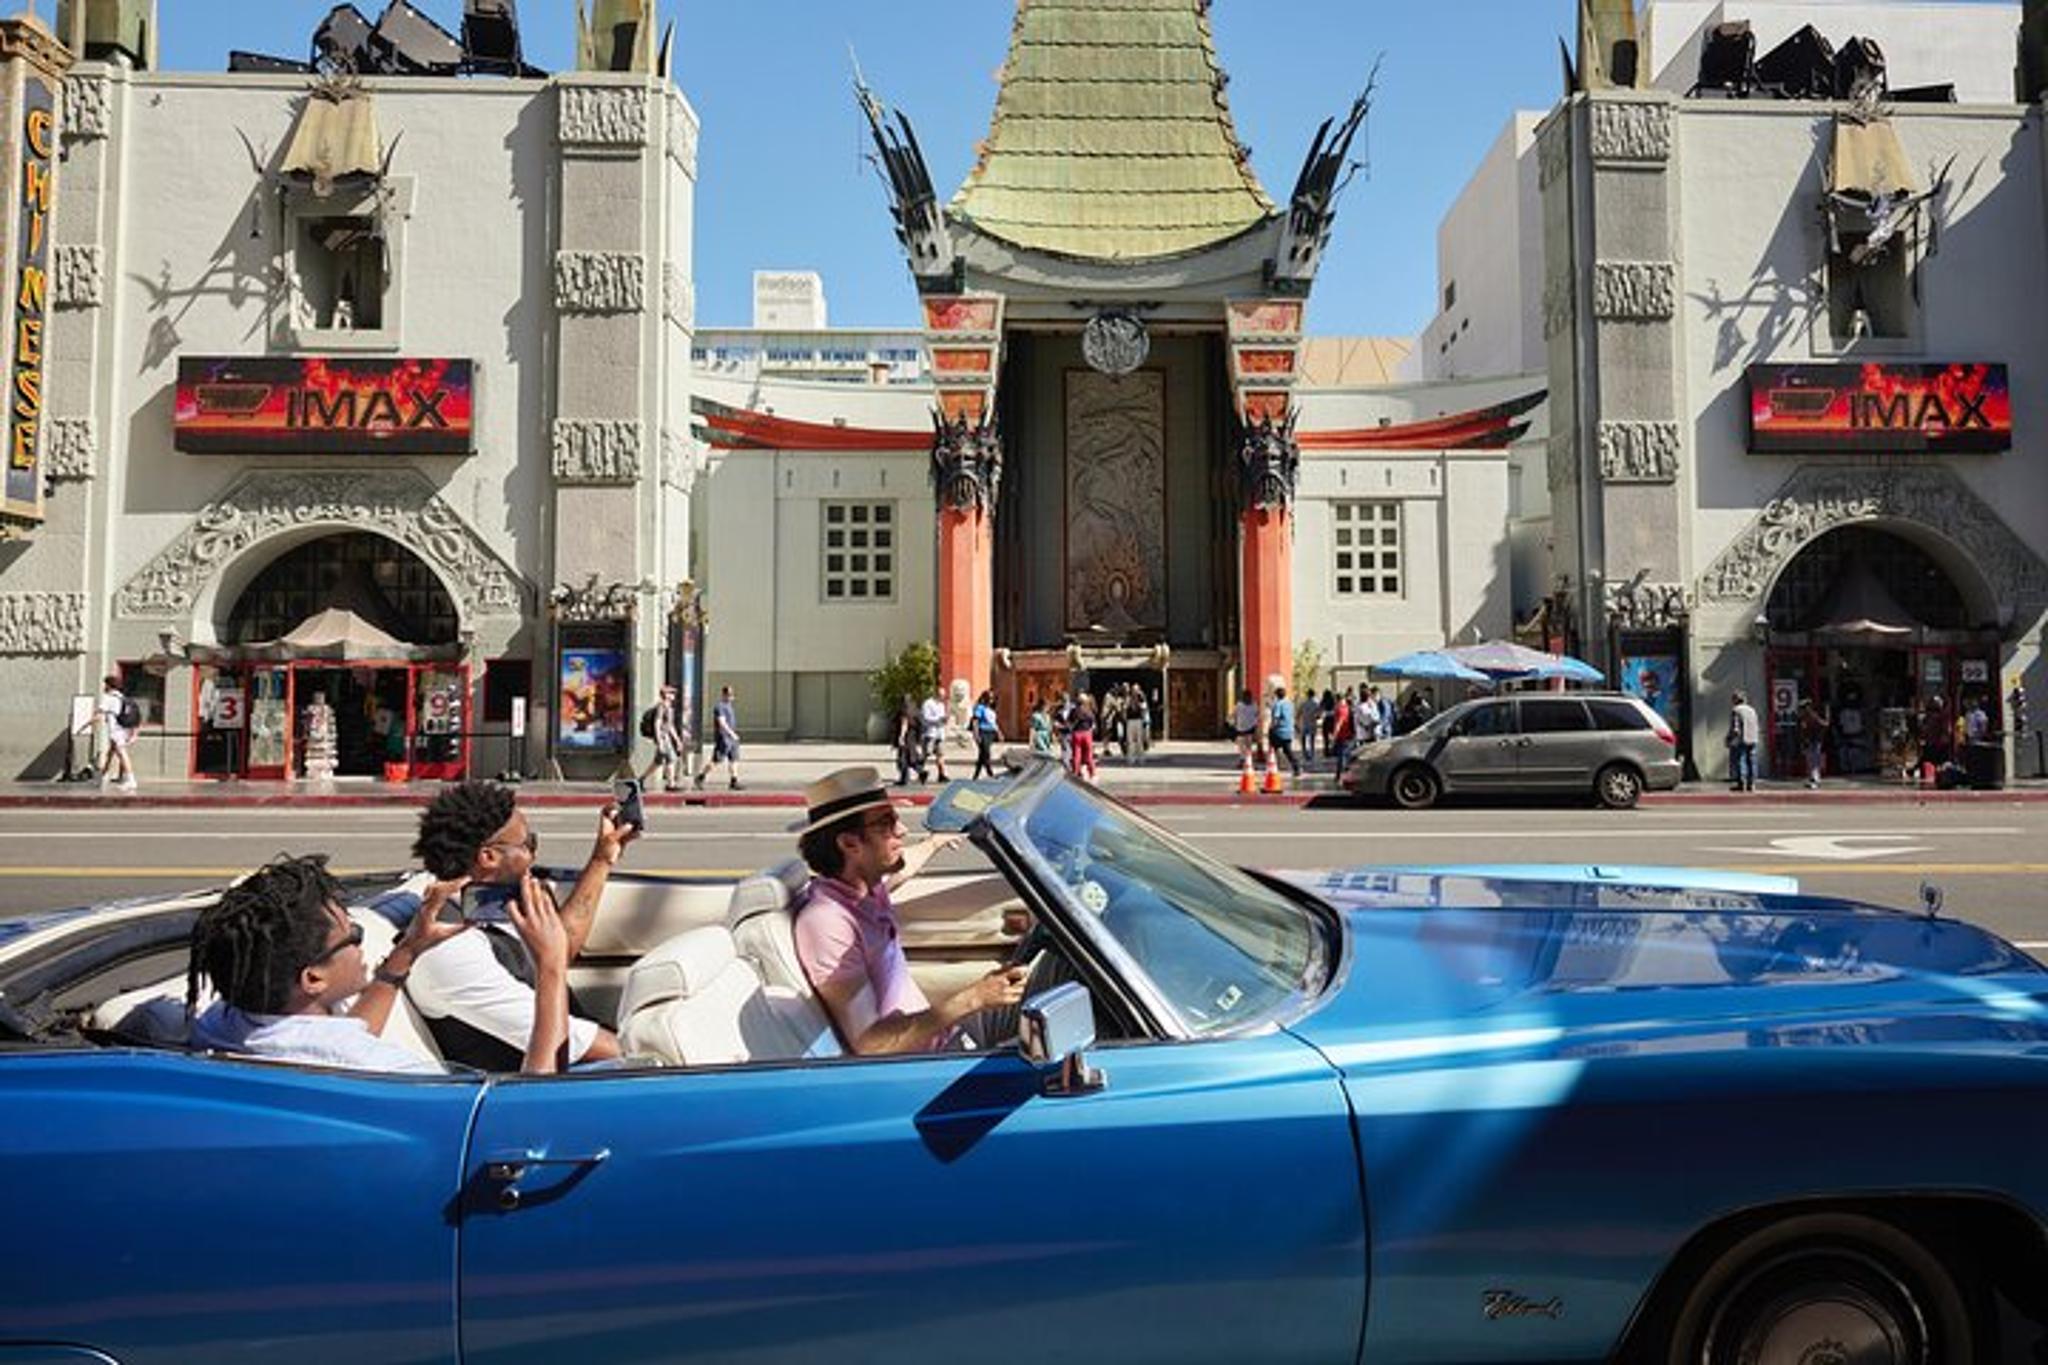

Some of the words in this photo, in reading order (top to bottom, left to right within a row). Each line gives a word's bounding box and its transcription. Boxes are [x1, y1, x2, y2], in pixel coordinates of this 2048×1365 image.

[14, 109, 53, 470] CHINESE
[286, 388, 449, 428] IMAX
[1851, 393, 1992, 429] IMAX
[219, 696, 238, 721] 3
